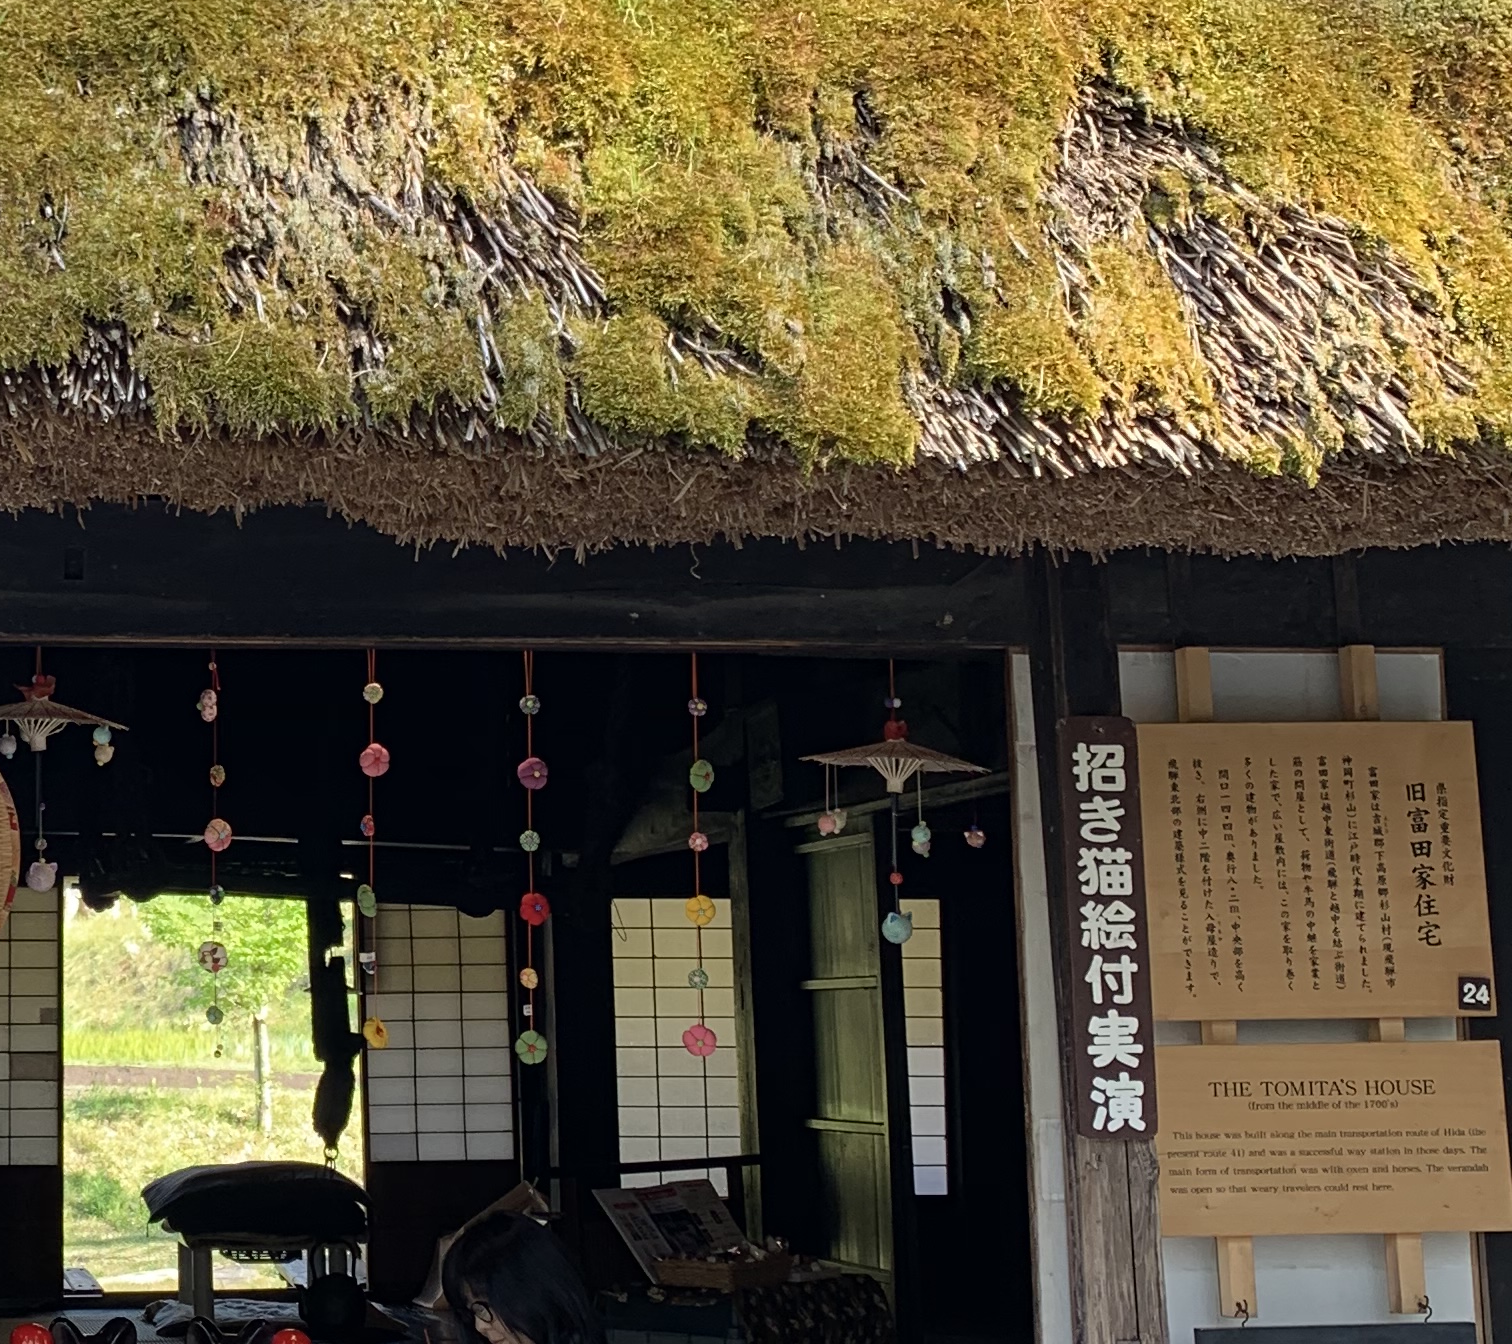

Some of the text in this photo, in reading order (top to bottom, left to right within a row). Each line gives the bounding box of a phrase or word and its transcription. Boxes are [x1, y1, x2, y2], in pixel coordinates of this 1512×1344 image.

[1435, 782, 1455, 886] 県指定重要文化財
[1406, 782, 1442, 947] 旧富田家住宅
[1072, 742, 1147, 1134] 招き猫絵付実演
[1463, 982, 1490, 1005] 24
[1208, 1078, 1436, 1098] THE TOMITA'S HOUSE
[1248, 1101, 1275, 1111] (from
[1278, 1101, 1294, 1110] the
[1296, 1101, 1329, 1110] middle
[1331, 1100, 1342, 1109] of
[1344, 1100, 1361, 1109] the
[1172, 1131, 1193, 1140] This
[1195, 1131, 1221, 1139] house
[1244, 1130, 1267, 1139] built
[1270, 1130, 1295, 1140] along
[1298, 1130, 1312, 1138] the
[1314, 1130, 1337, 1138] main
[1339, 1129, 1403, 1139] transportation
[1405, 1129, 1429, 1137] route
[1431, 1128, 1440, 1137] of
[1443, 1128, 1465, 1137] Hida
[1167, 1150, 1199, 1159] present
[1248, 1149, 1266, 1157] and
[1269, 1149, 1287, 1157] was
[1298, 1148, 1343, 1157] successful
[1347, 1148, 1367, 1156] way
[1370, 1147, 1400, 1155] station
[1404, 1147, 1413, 1155] in
[1416, 1147, 1440, 1155] those
[1469, 1146, 1487, 1154] The
[1168, 1168, 1192, 1176] main
[1195, 1167, 1217, 1176] form
[1219, 1167, 1230, 1175] of
[1233, 1166, 1297, 1176] transportation
[1321, 1165, 1344, 1174] with
[1346, 1166, 1369, 1174] oxen
[1372, 1165, 1388, 1173] and
[1425, 1164, 1444, 1173] The
[1447, 1164, 1489, 1173] verandah
[1169, 1186, 1188, 1194] was
[1190, 1186, 1213, 1195] open
[1228, 1185, 1247, 1193] that
[1250, 1185, 1278, 1194] weary
[1282, 1184, 1322, 1193] travelers
[1323, 1183, 1349, 1192] could
[1352, 1183, 1369, 1191] rest
